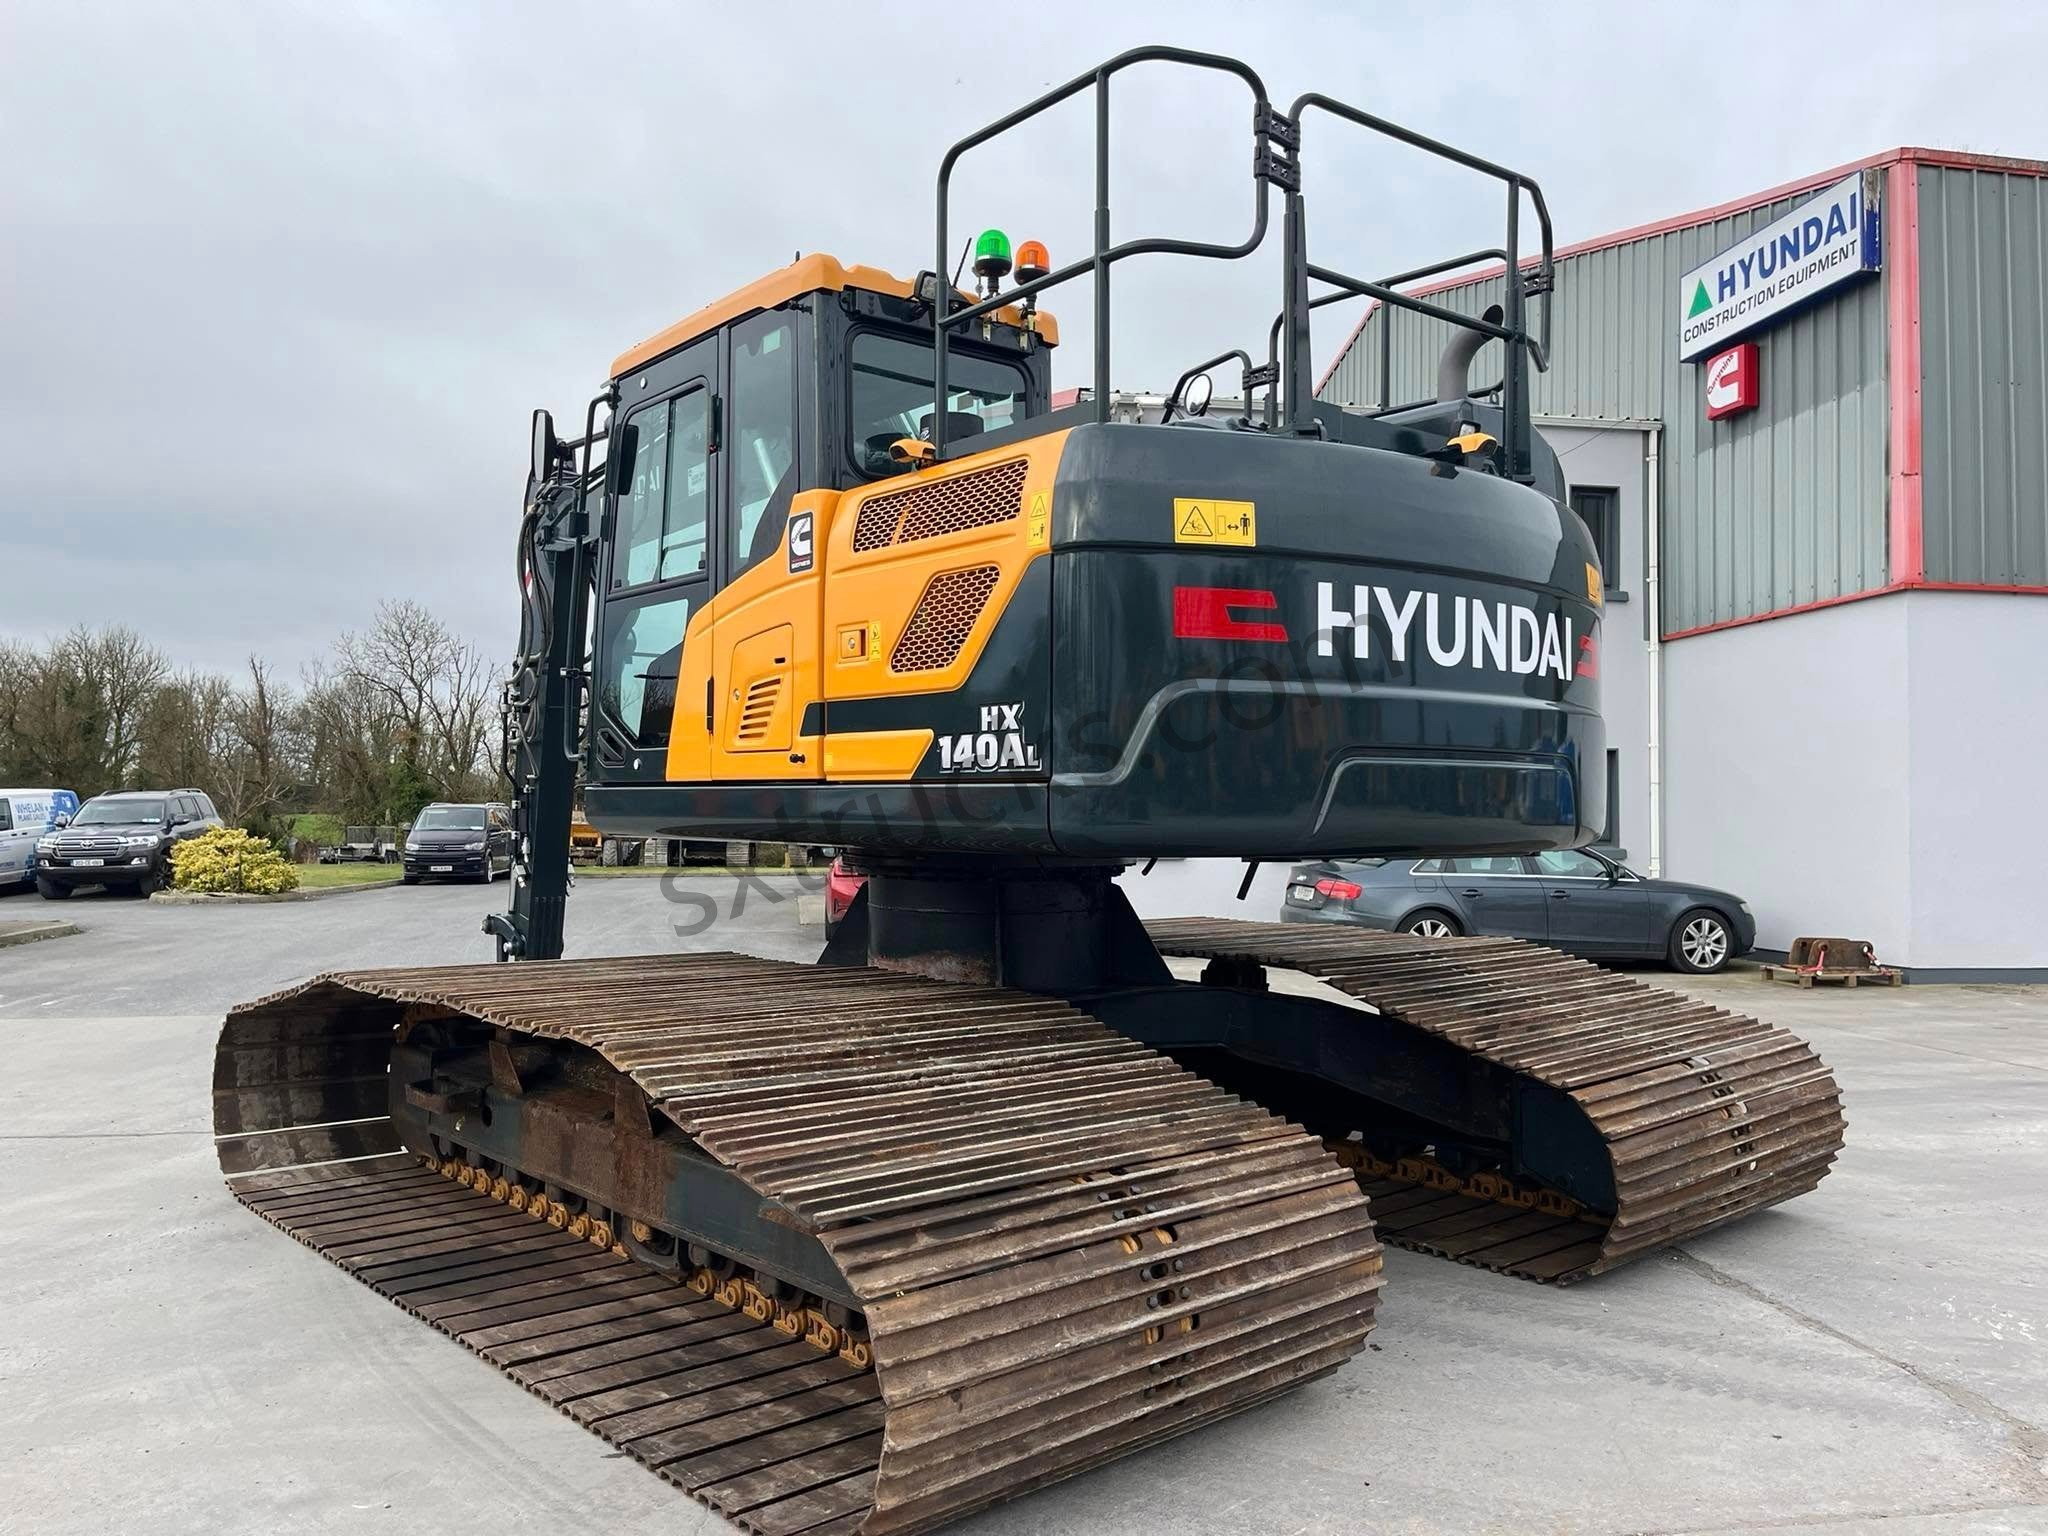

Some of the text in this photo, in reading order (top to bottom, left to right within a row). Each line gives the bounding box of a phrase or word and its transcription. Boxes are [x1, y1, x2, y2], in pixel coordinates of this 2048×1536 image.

[1717, 192, 1857, 304] HYUNDAI
[1683, 239, 1858, 343] CONSTRUCTION EQUIPMENT
[1707, 354, 1735, 395] Cummins
[1317, 581, 1573, 681] HYUNDAI
[980, 703, 1021, 732] HX
[15, 802, 44, 814] WHELAN
